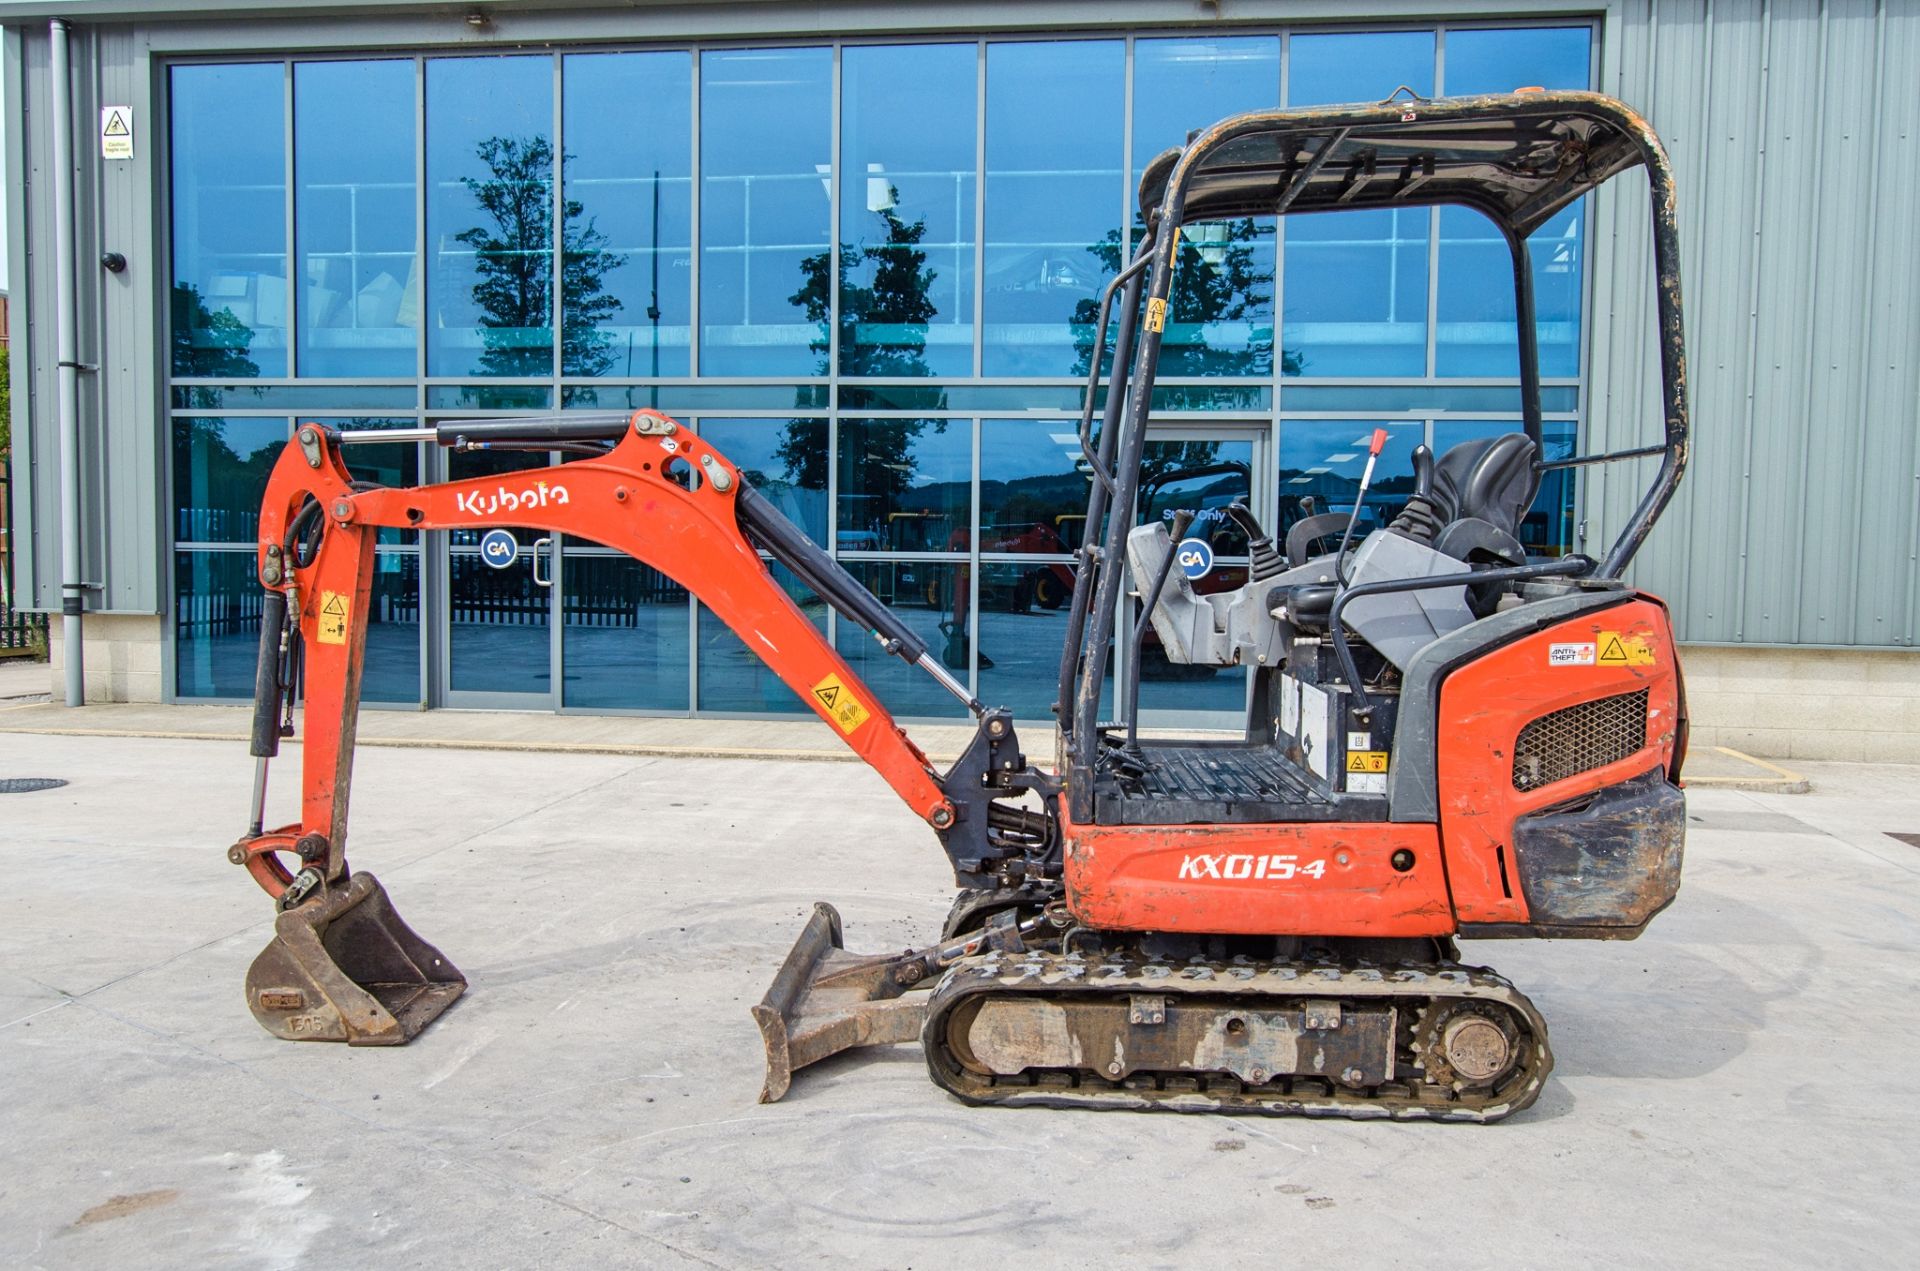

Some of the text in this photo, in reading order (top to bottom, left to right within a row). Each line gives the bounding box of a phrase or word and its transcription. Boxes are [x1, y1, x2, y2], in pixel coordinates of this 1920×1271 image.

[457, 482, 570, 516] Kubota
[1197, 508, 1226, 523] Only
[487, 542, 511, 556] GA
[1179, 551, 1206, 567] GA
[1178, 854, 1326, 879] KX015-4
